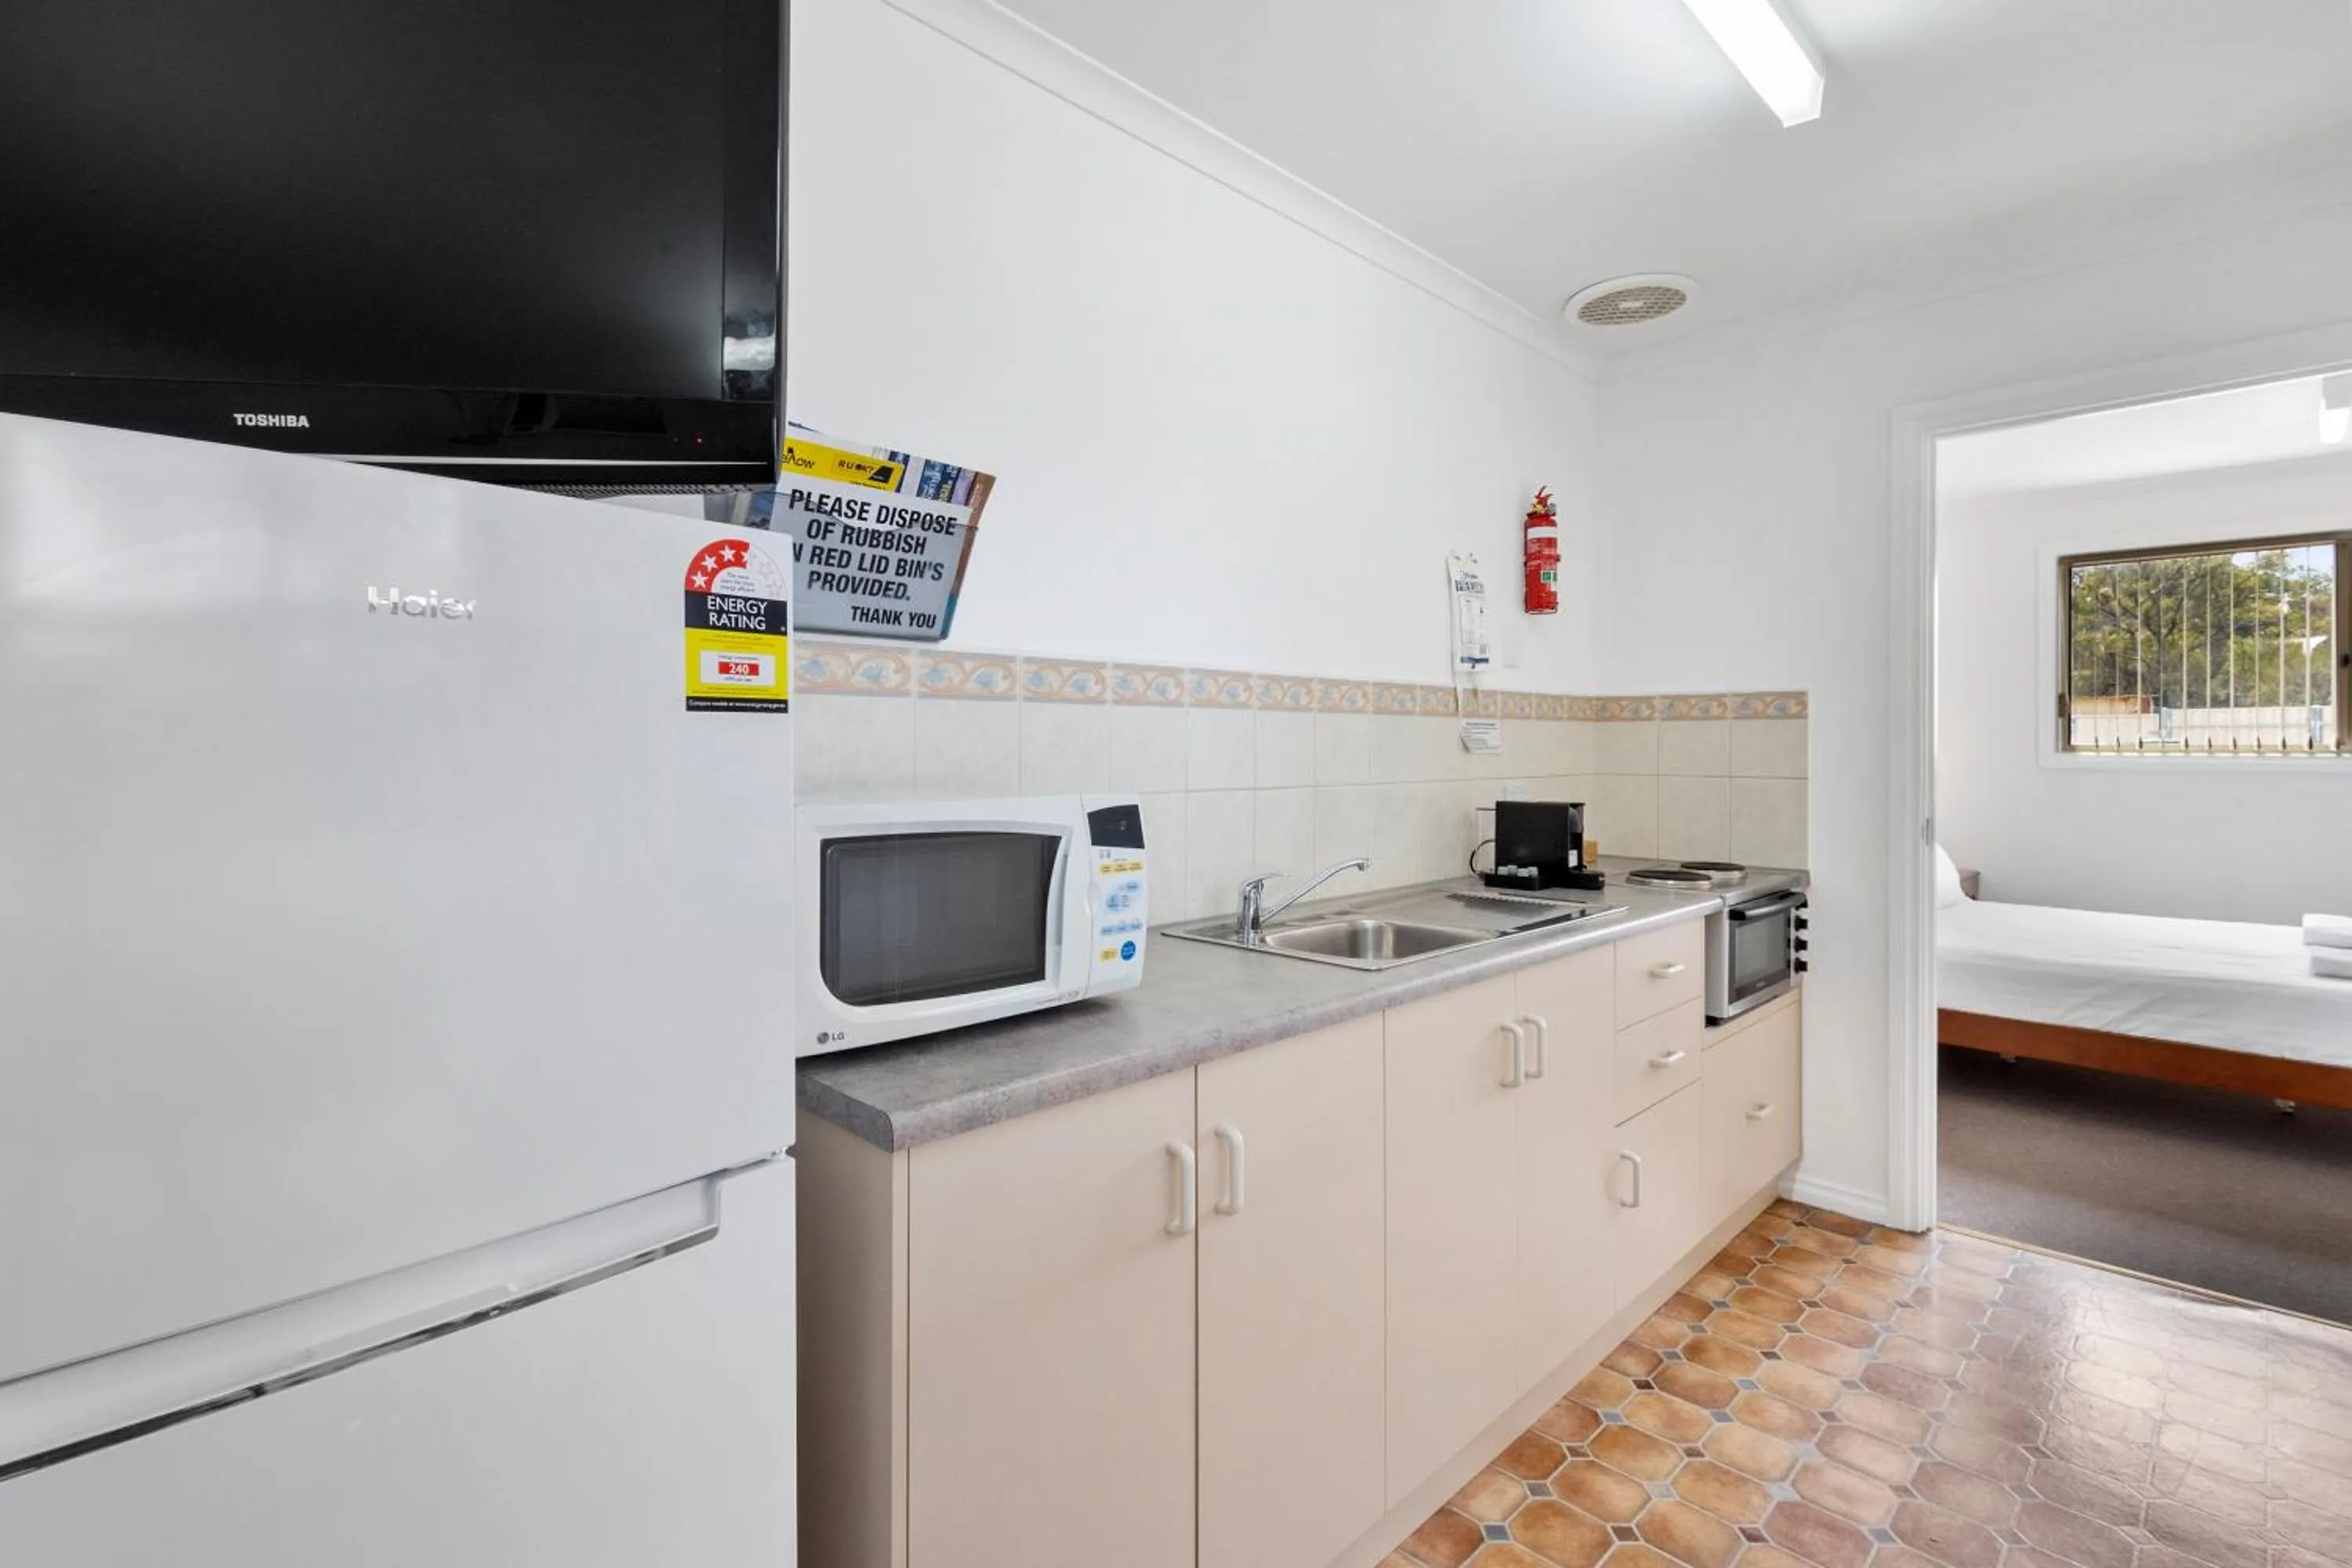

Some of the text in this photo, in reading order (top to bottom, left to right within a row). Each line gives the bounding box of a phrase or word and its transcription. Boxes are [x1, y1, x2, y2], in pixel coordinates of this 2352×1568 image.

[233, 413, 310, 429] TOSHIBA
[788, 488, 957, 535] PLEASE DISPOSE
[806, 518, 927, 555] OF RUBBISH
[793, 543, 945, 581] N RED LID BIN'S
[808, 570, 911, 601] PROVIDED.
[368, 586, 477, 620] Haier
[707, 595, 768, 615] ENERGY
[709, 612, 766, 630] RATING
[851, 605, 938, 629] THANK YOU
[831, 1031, 845, 1041] LG
